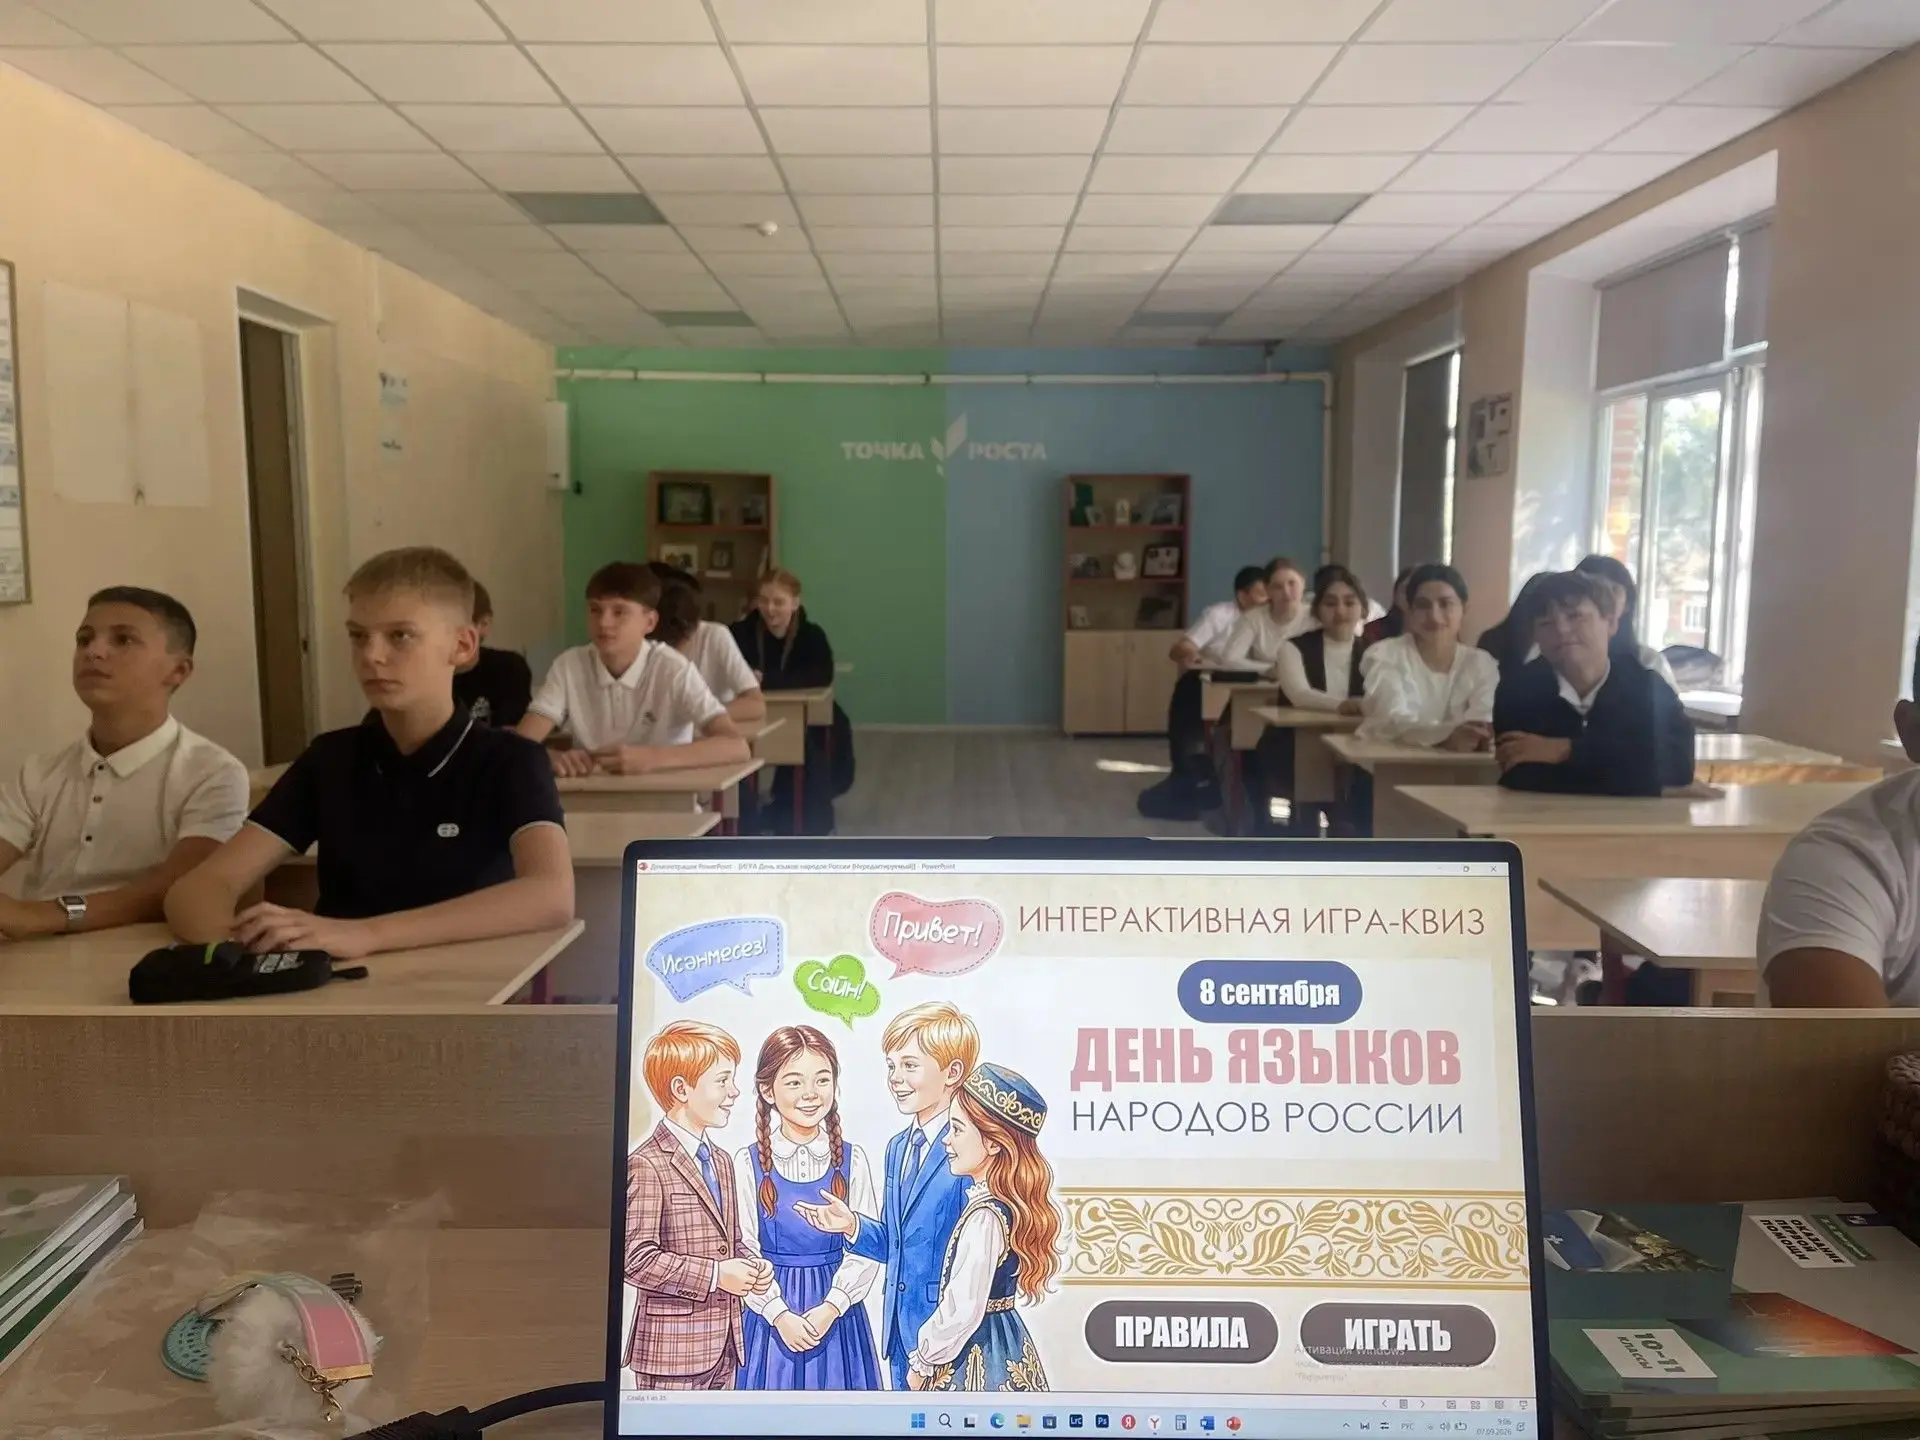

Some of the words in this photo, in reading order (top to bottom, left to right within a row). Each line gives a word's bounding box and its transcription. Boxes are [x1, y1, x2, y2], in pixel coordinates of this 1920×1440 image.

[841, 441, 924, 460] ТОЧКА
[968, 441, 1047, 460] РОСТА
[882, 910, 982, 947] Привет!
[1020, 905, 1290, 934] ИНТЕРАКТИВНАЯ
[1303, 907, 1485, 935] ИГРА-КВИЗ
[807, 968, 867, 1001] Сайн!
[1199, 978, 1214, 1005] 8
[1221, 979, 1340, 1008] сентября
[1070, 1027, 1213, 1092] ДЕНЬ
[1227, 1028, 1461, 1085] ЯЗЫКОВ
[1073, 1101, 1270, 1136] НАРОДОВ
[1285, 1102, 1463, 1134] РОССИИ
[1760, 1219, 1810, 1260] ПОМОЩИ
[1774, 1219, 1819, 1252] ПЕРВОЙ
[1790, 1219, 1845, 1264] ОКАЗАНИЕ
[1115, 1315, 1249, 1348] ПРАВИЛА
[1344, 1318, 1452, 1352] ИГРАТЬ
[1617, 1336, 1653, 1369] КЛАССЫ
[1634, 1333, 1685, 1372] 10-11
[1098, 1417, 1107, 1425] Ps
